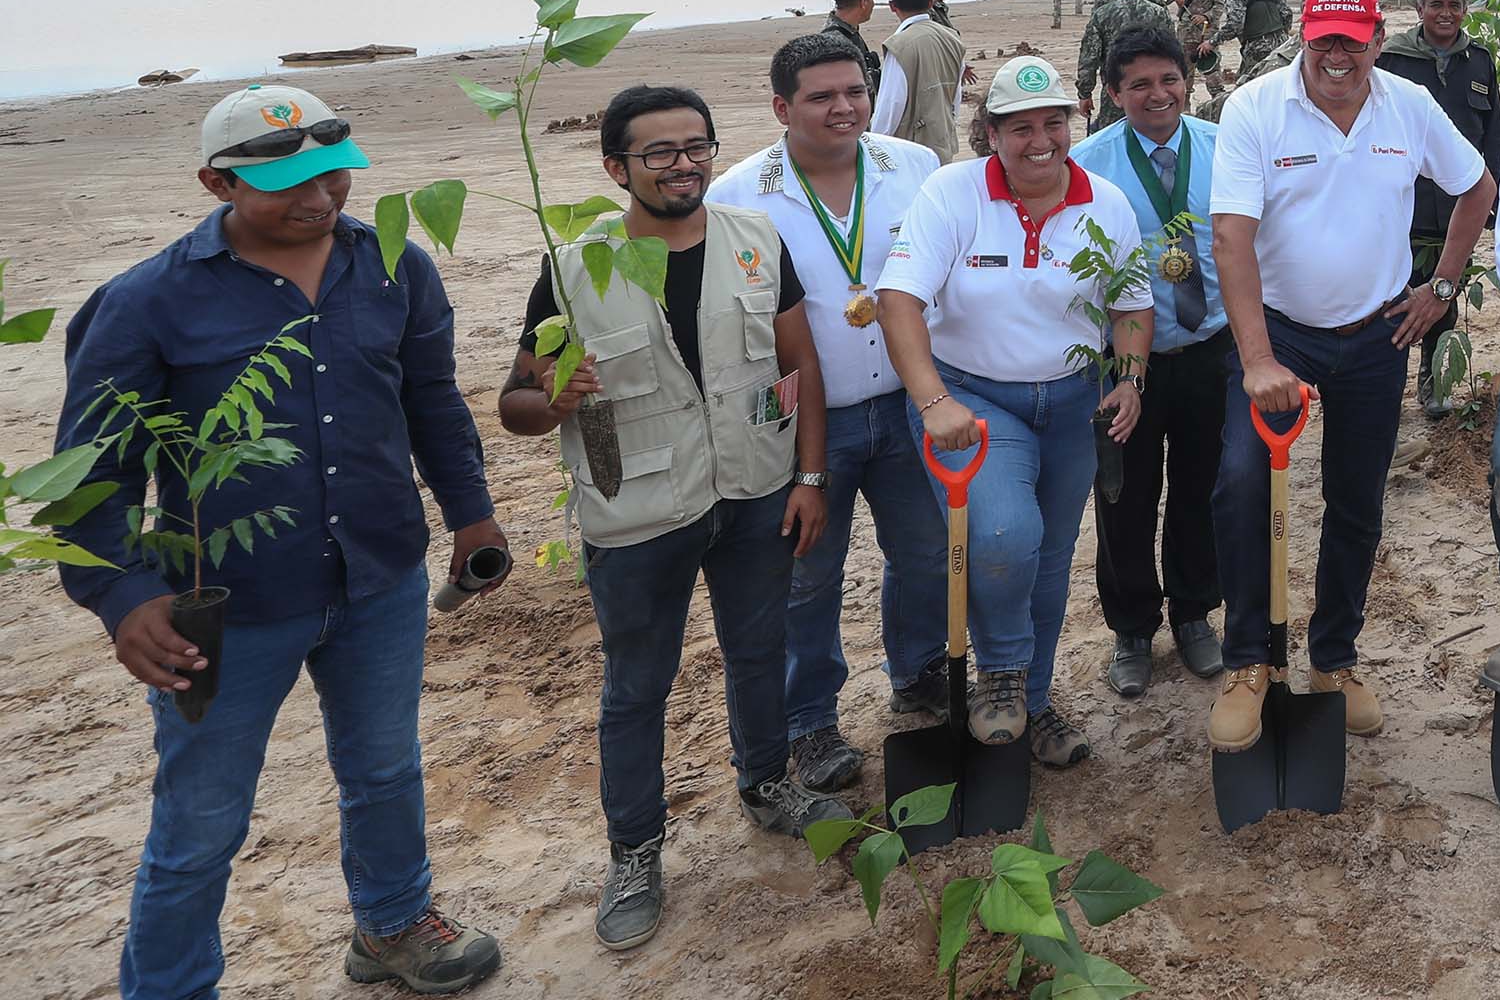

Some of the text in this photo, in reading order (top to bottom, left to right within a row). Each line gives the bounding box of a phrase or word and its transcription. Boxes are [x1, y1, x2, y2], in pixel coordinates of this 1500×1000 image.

[1312, 5, 1323, 13] DE
[1324, 3, 1366, 13] DEFENSA
[953, 548, 962, 571] TITAN
